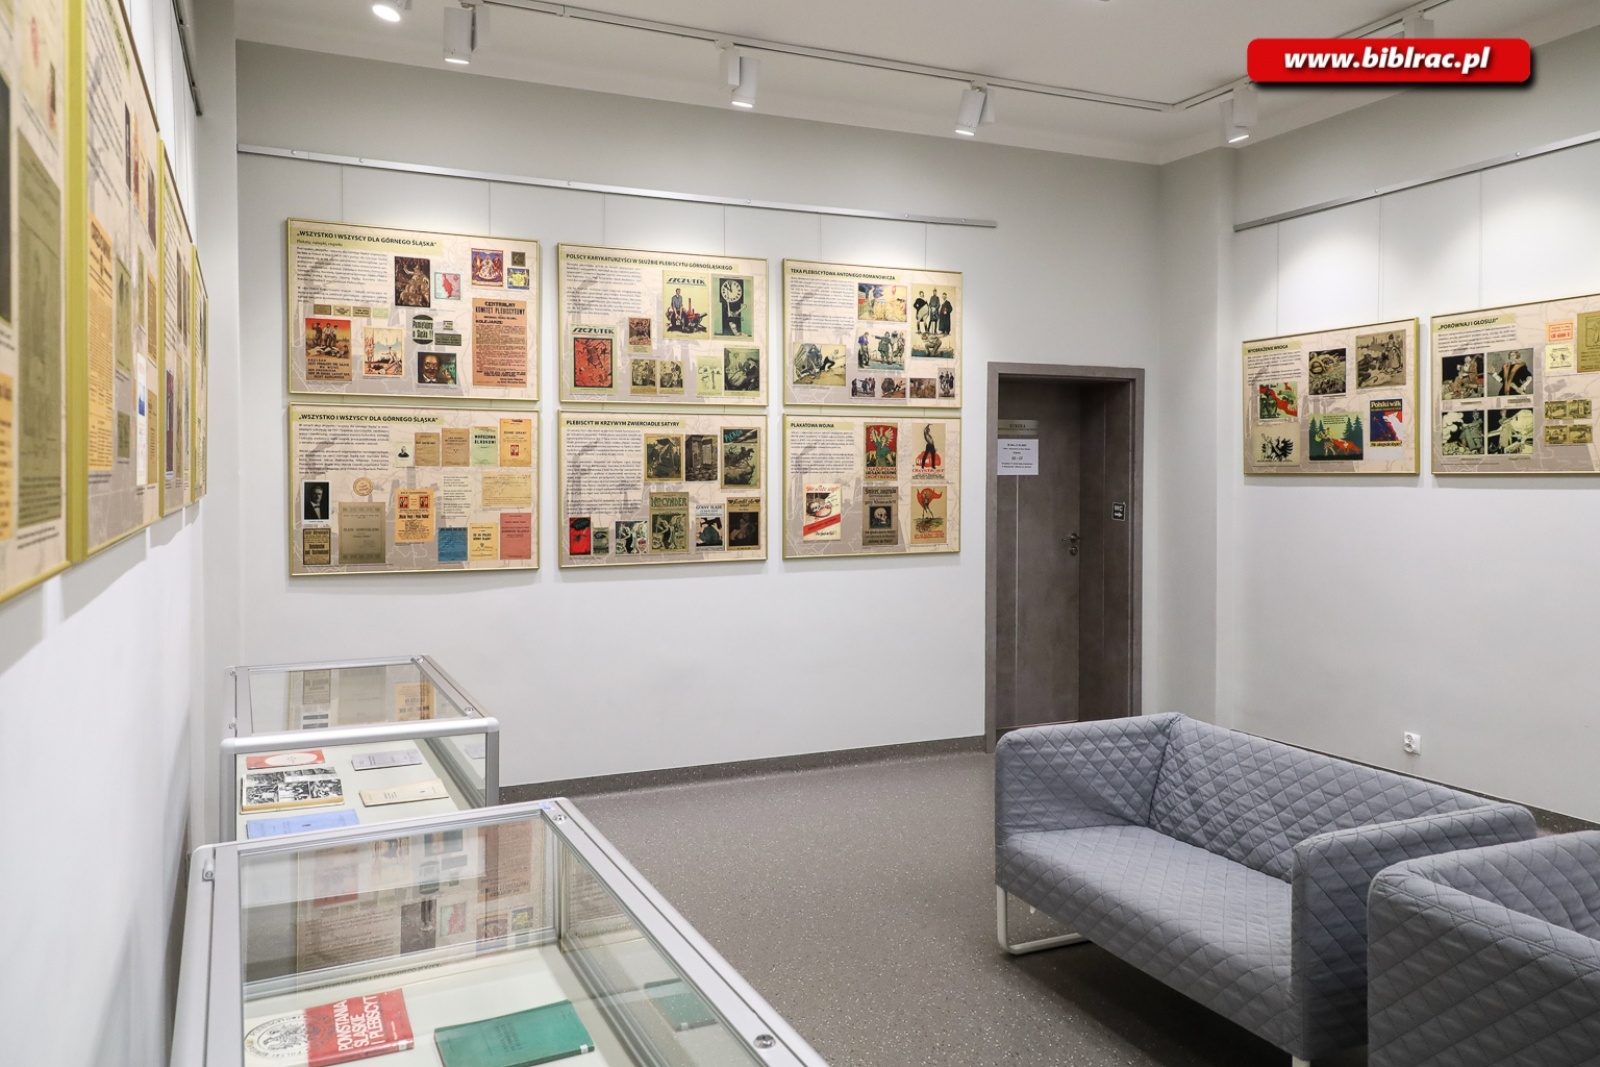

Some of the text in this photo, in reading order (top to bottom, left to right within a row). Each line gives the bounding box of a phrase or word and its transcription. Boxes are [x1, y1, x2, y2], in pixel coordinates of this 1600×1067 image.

[381, 236, 411, 245] GÓRNEGO
[587, 254, 632, 263] KARYKATURZYŚCI
[638, 258, 658, 266] SŁUŻBIE
[658, 260, 688, 268] PLEBISCYTU
[688, 261, 733, 270] GÓRNOŚLĄSKIEGO
[333, 999, 353, 1052] POWSTANIA
[362, 996, 384, 1041] PLEBISCYT
